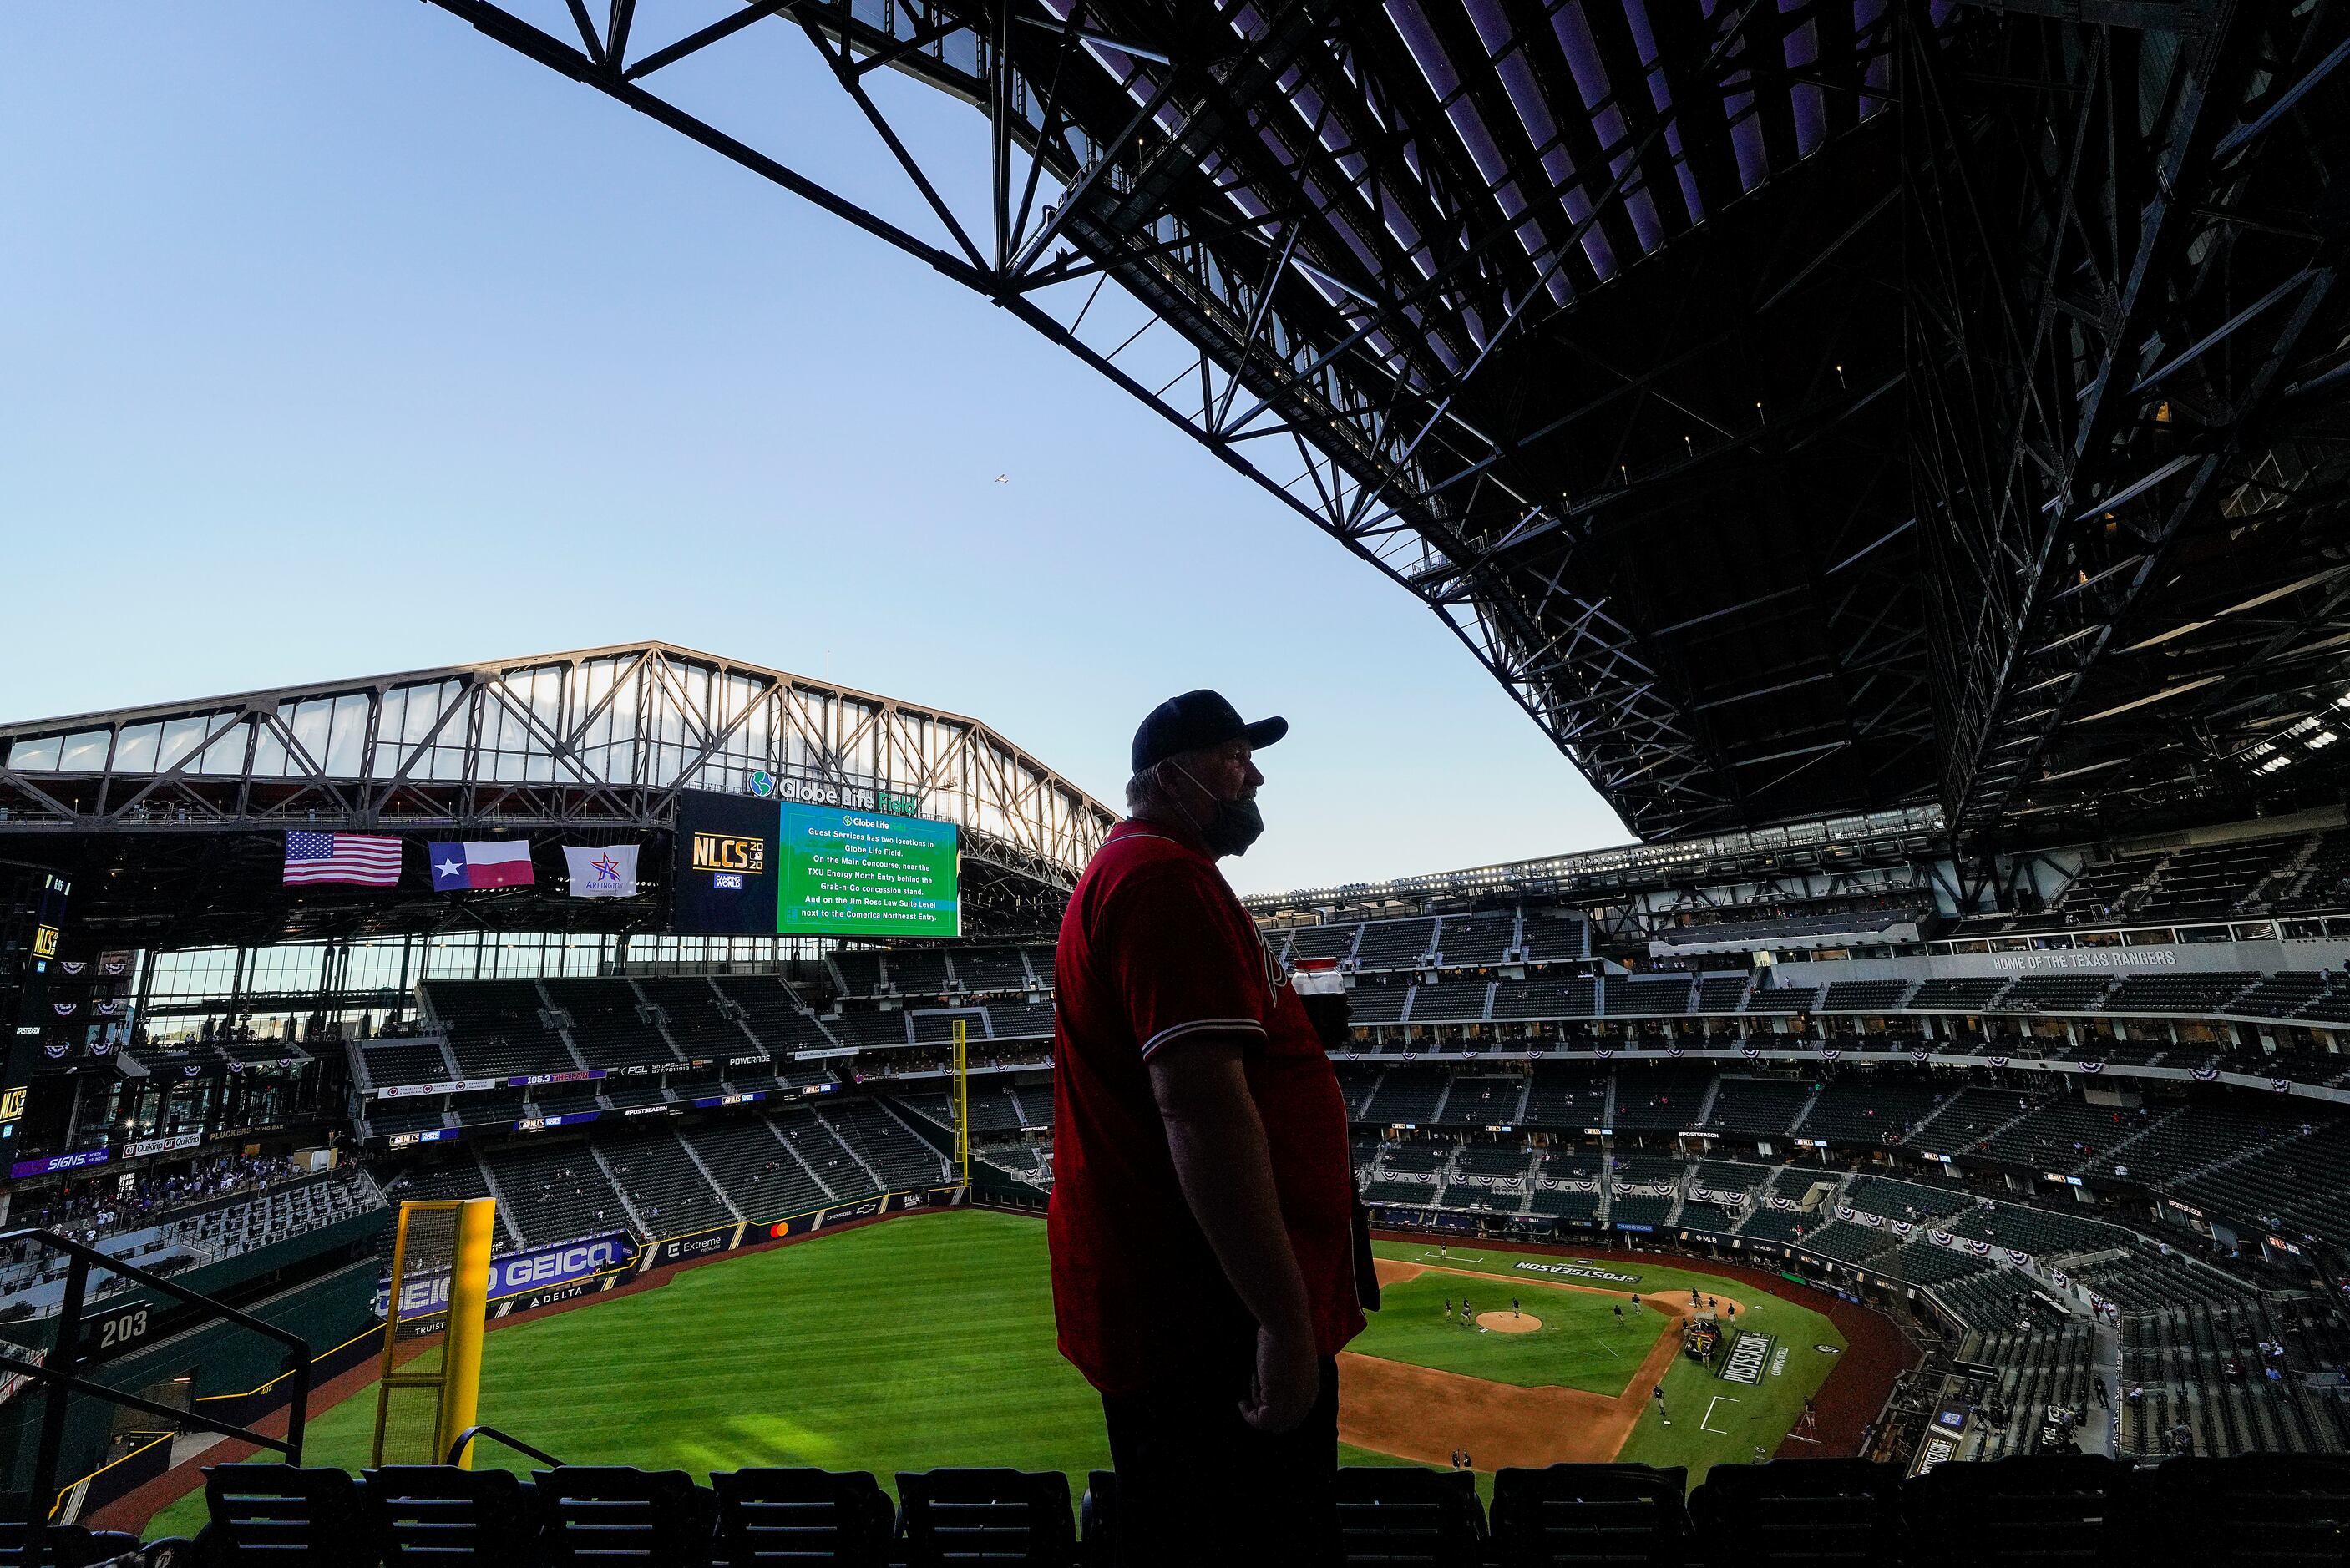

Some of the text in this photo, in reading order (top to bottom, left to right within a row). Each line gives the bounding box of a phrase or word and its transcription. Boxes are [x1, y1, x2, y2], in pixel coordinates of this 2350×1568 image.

[779, 778, 917, 815] Globe Life Field
[853, 817, 875, 827] Globe
[876, 821, 889, 829] Life
[808, 827, 831, 837] Guest
[833, 831, 864, 841] Services
[895, 837, 926, 847] locations
[693, 837, 748, 868] NLCS
[749, 842, 764, 852] 20
[844, 844, 904, 857] Globe Life Field.
[748, 860, 763, 870] 20
[827, 856, 839, 864] the
[841, 857, 859, 866] Main
[862, 859, 901, 870] Concourse,
[808, 867, 824, 876] TXU
[827, 869, 853, 879] Energy
[854, 871, 875, 880] North
[877, 873, 895, 883] Entry
[897, 874, 919, 883] behind
[586, 881, 623, 889] ARLINGTON
[820, 882, 924, 896] Grab-n-Go concession stand.
[805, 895, 821, 903] And
[849, 897, 862, 905] Jim
[899, 899, 917, 908] Suite
[846, 910, 881, 918] Comerica
[883, 912, 917, 920] Northeast
[918, 913, 937, 922] Entry.
[34, 928, 54, 954] NLCS
[1993, 950, 2177, 970] HOME OF THE TEXAS RANGERS
[730, 1055, 771, 1065] POWERADE
[627, 1065, 648, 1074] PGL
[527, 1071, 589, 1084] 105.3 THE FAN
[0, 1091, 21, 1119] NLCS
[625, 1106, 668, 1115] #POSTSEASON
[210, 1127, 251, 1141] PLUCKERS
[124, 1135, 200, 1156] QT QuikTrip QT QuikTrip
[48, 1154, 86, 1170] SIGNS
[118, 1179, 134, 1187] SLAM
[119, 1172, 135, 1181] GRAND
[826, 1210, 855, 1221] CHEVROLET
[2168, 1200, 2203, 1217] #POSTSEASON
[683, 1237, 721, 1252] Extreme
[1702, 1236, 1717, 1244] MLB
[701, 1244, 721, 1253] networks
[505, 1242, 612, 1287] GEICO
[1516, 1262, 1628, 1282] POSTSEASON
[544, 1287, 583, 1304] DELTA
[101, 1310, 148, 1348] 203
[415, 1322, 445, 1335] TRUIST
[1722, 1335, 1770, 1384] POSTSEASON
[261, 1384, 273, 1395] 407
